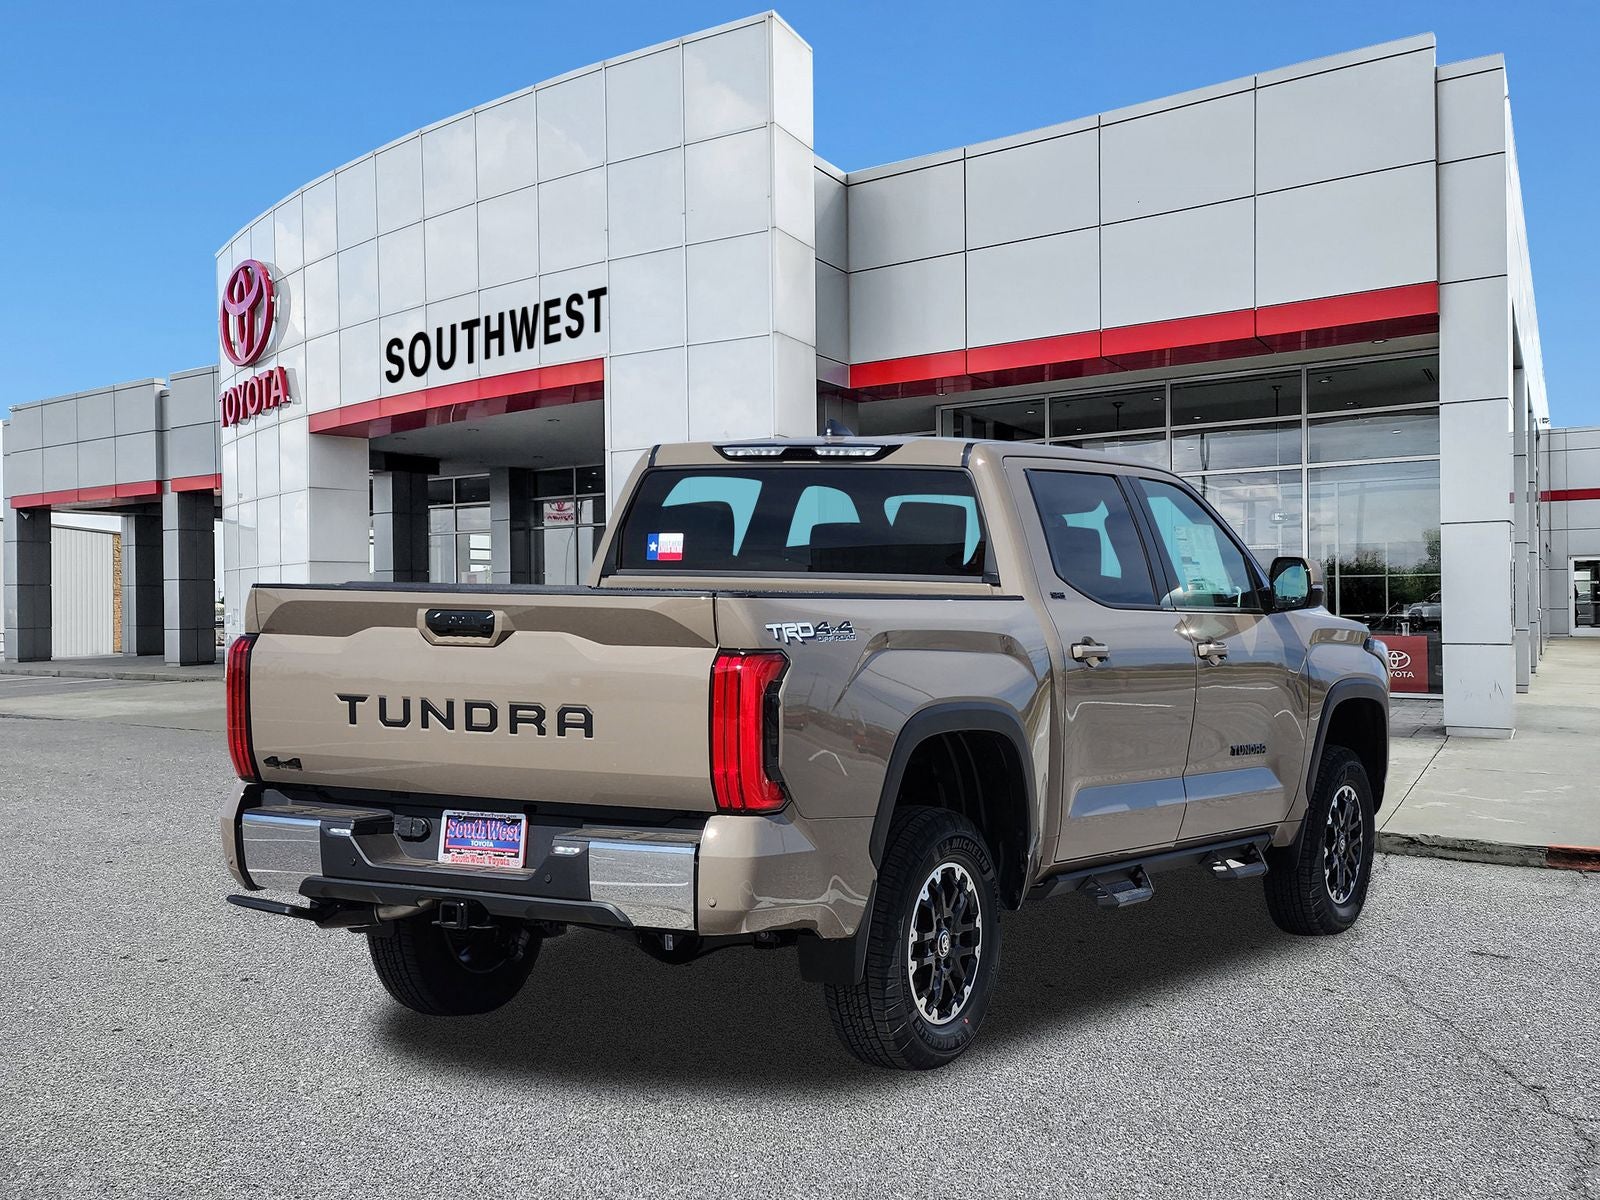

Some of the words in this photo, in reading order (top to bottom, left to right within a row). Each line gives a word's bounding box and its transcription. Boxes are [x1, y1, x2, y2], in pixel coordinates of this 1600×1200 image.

[385, 286, 608, 383] SOUTHWEST
[219, 366, 291, 427] TOYOTA
[765, 622, 816, 643] TRD
[335, 693, 594, 739] TUNDRA
[487, 855, 510, 867] Toyota
[952, 837, 990, 873] MICHELIN
